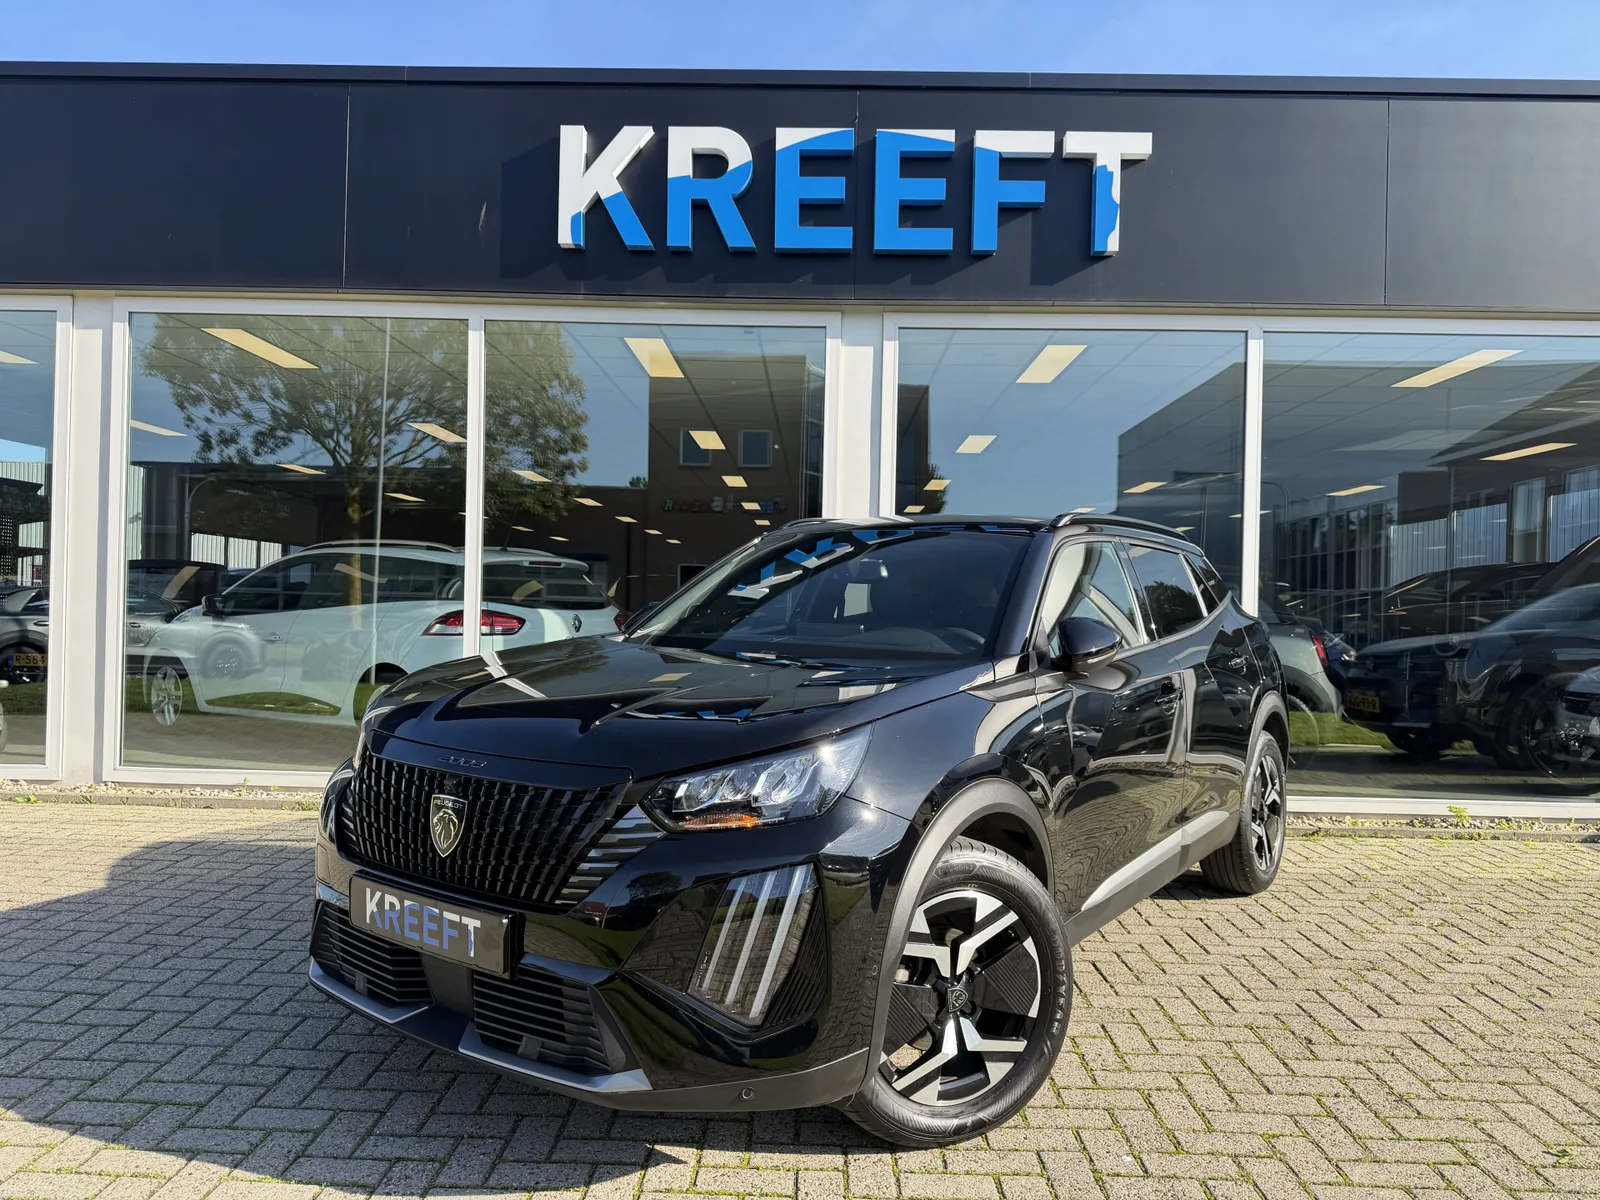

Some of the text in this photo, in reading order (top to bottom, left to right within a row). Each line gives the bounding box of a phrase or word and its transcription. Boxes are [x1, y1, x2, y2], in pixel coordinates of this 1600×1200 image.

[557, 124, 1153, 257] KREEFT
[439, 755, 487, 769] 2008
[433, 798, 464, 810] PEUGEOT
[366, 887, 481, 958] KREEFT
